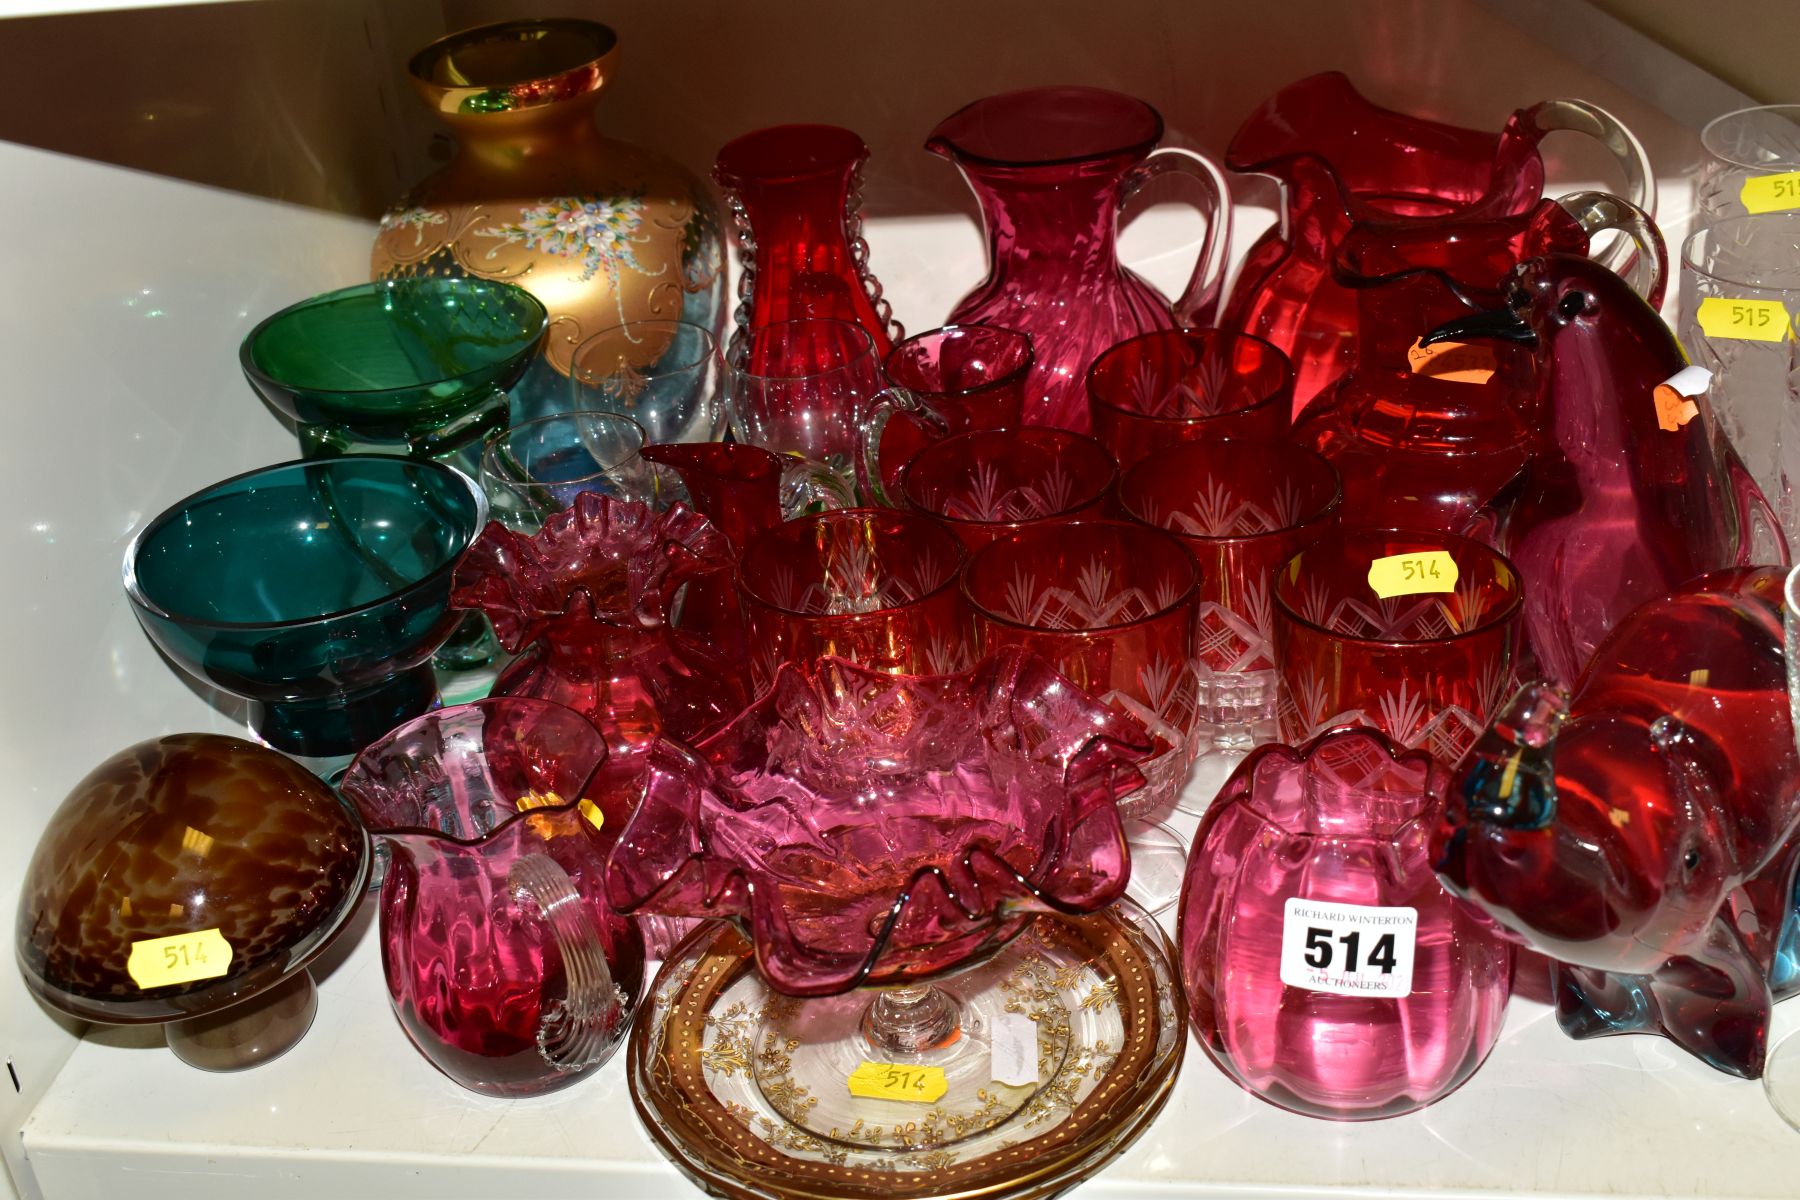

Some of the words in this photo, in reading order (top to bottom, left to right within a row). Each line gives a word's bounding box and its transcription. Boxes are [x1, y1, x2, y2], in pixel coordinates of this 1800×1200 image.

[1773, 179, 1800, 198] 51
[1732, 306, 1770, 327] 515
[1401, 559, 1440, 580] 514
[1293, 906, 1346, 922] RICHARD
[1347, 912, 1414, 925] WINTERTON
[163, 941, 208, 969] 514
[1304, 926, 1397, 974] 514
[1308, 974, 1388, 990] AUCTIONEERS
[884, 1071, 926, 1091] 514
